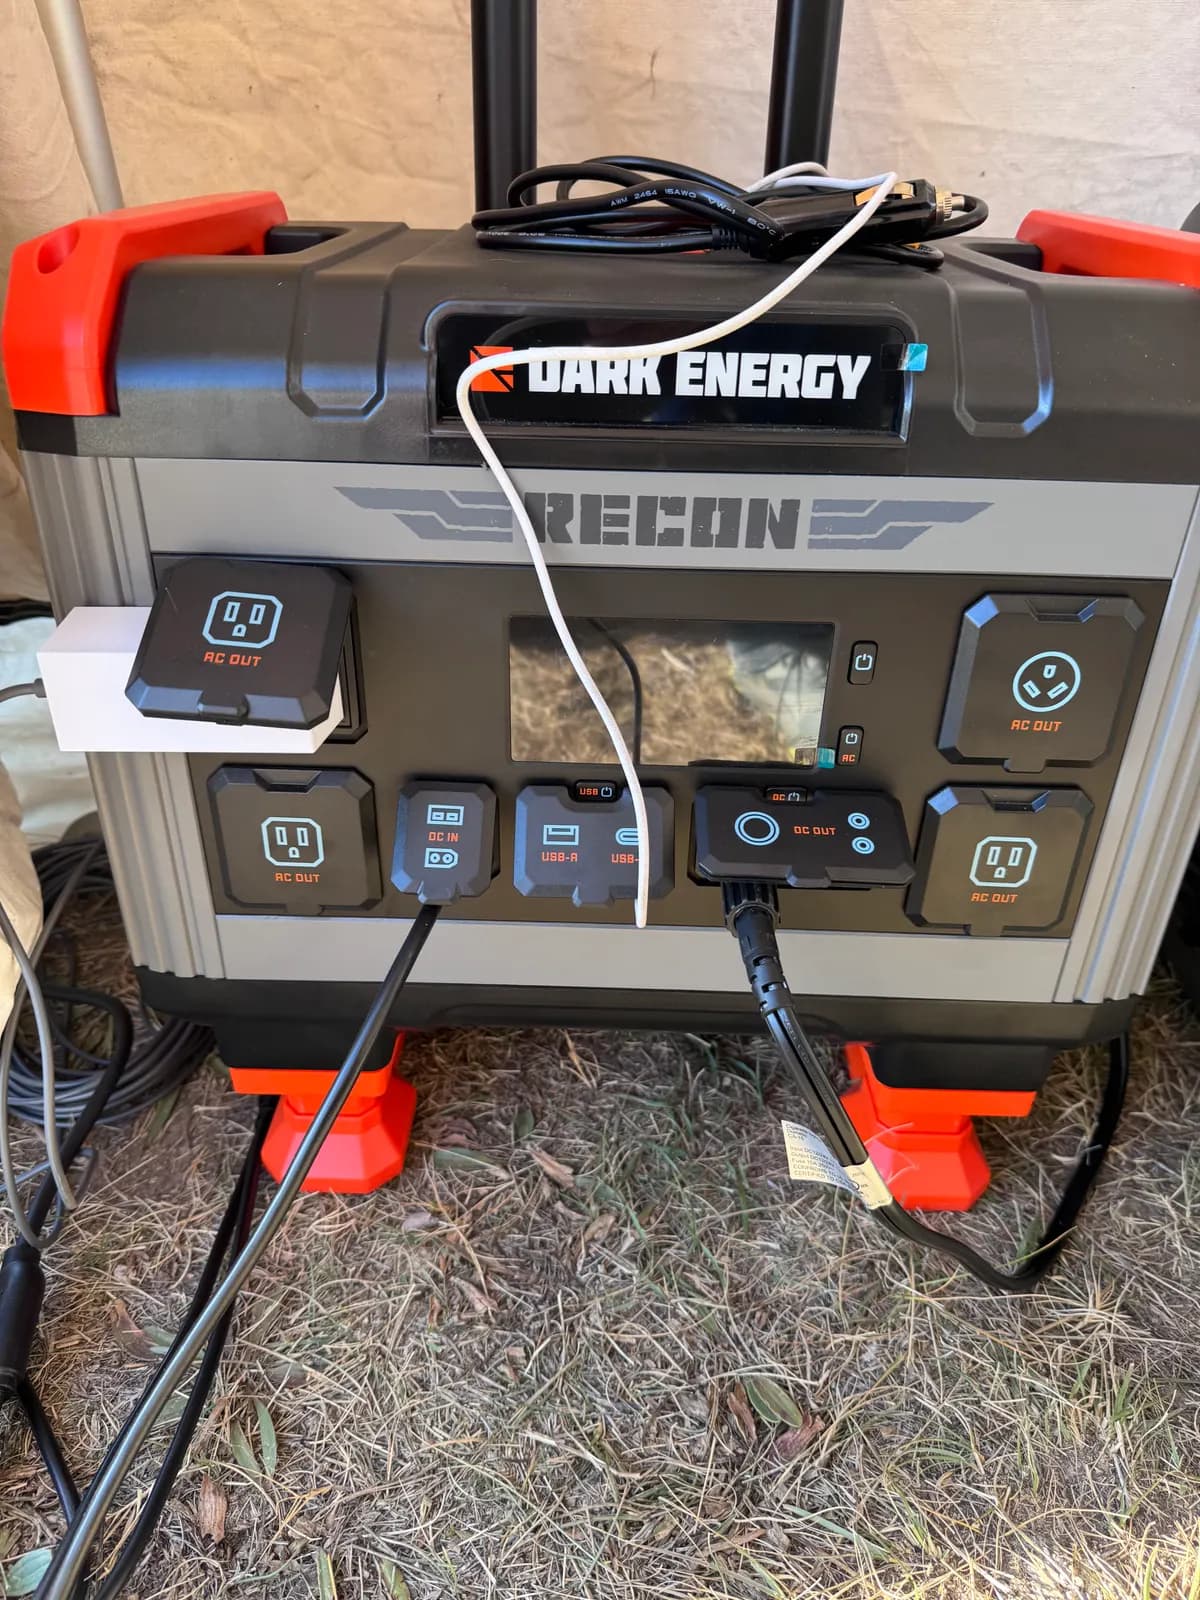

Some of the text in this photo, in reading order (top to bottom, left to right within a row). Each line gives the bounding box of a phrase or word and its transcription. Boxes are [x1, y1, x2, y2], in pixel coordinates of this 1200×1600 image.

[528, 347, 871, 400] DARK ENERGY
[524, 492, 801, 550] RECON
[203, 651, 262, 667] AC OUT
[1011, 719, 1062, 732] AC OUT
[841, 754, 856, 763] AC
[579, 786, 599, 796] USB
[772, 793, 786, 801] DC
[793, 825, 837, 836] DC OUT
[428, 831, 459, 842] DC IN
[541, 851, 578, 862] USB-A
[611, 853, 640, 864] USB-
[275, 872, 321, 883] AC OUT
[970, 892, 1019, 904] AC OUT
